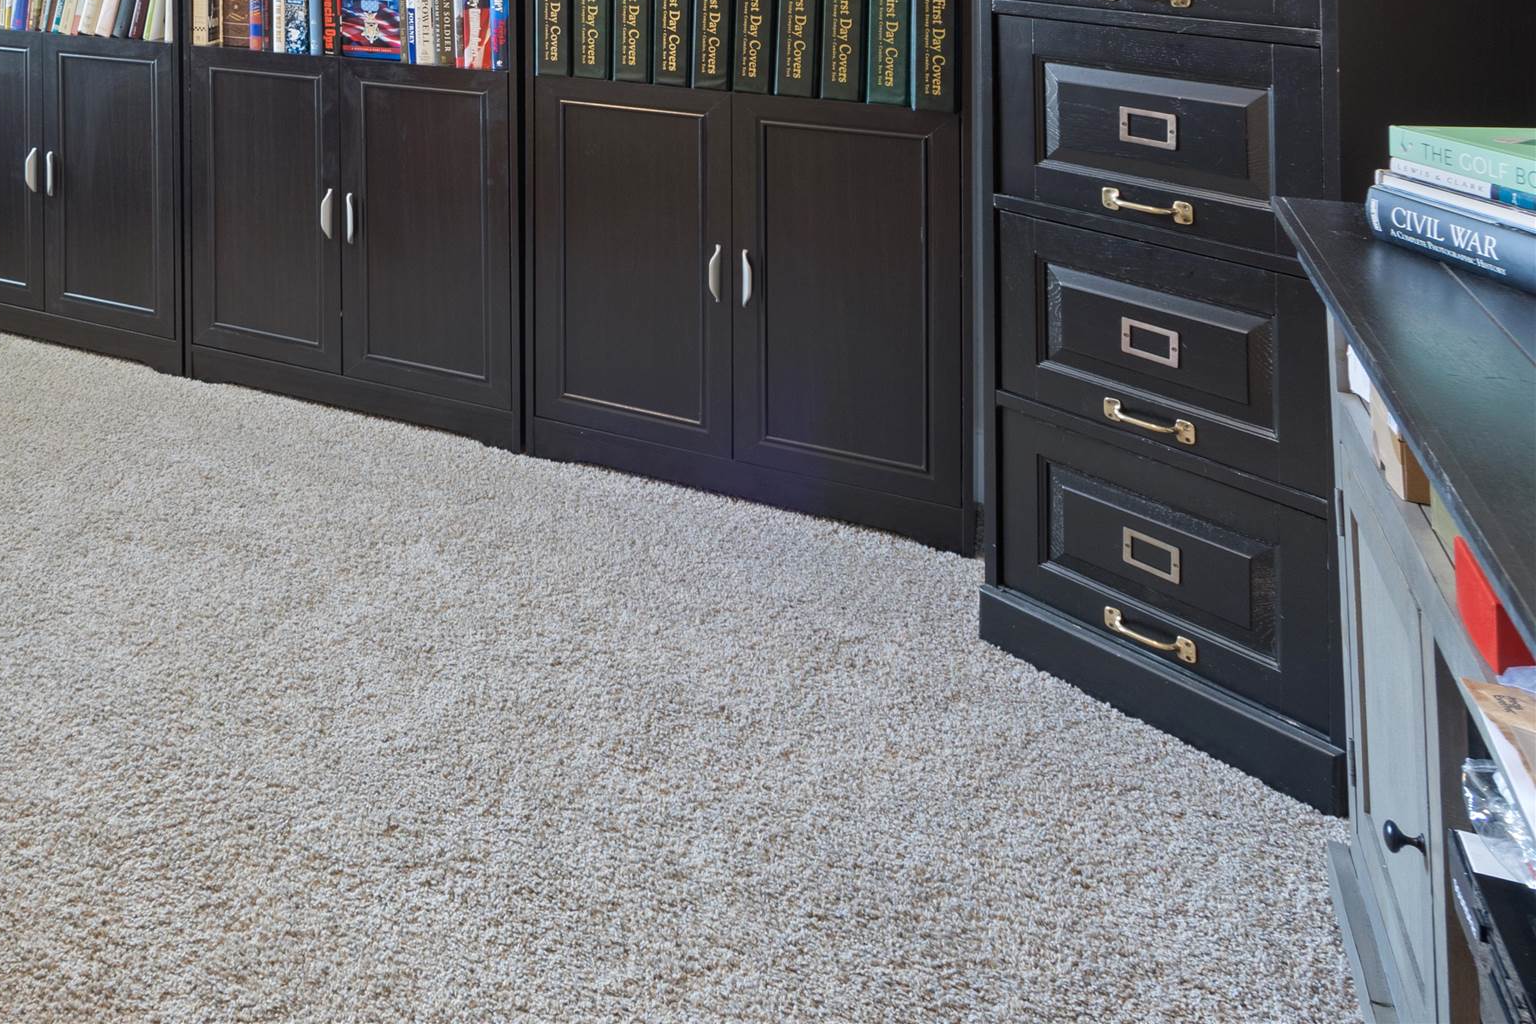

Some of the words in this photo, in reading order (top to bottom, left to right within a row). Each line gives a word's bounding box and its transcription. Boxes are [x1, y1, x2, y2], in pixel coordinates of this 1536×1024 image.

[421, 0, 430, 46] POWELL
[549, 3, 560, 24] Day
[586, 6, 598, 26] Day
[627, 5, 640, 26] Day
[667, 10, 680, 32] Day
[707, 13, 720, 34] Day
[793, 15, 806, 38] Day
[933, 0, 946, 24] First
[324, 29, 336, 49] Ops
[443, 12, 451, 52] SOLDIER
[748, 16, 762, 38] Day
[837, 19, 852, 42] Day
[884, 22, 900, 44] Day
[930, 29, 946, 52] Day
[551, 26, 560, 62] Covers
[588, 29, 598, 64] Covers
[628, 29, 640, 66] Covers
[668, 34, 680, 72] Covers
[708, 37, 720, 74] Covers
[748, 40, 762, 78] Covers
[793, 40, 806, 78] Covers
[839, 44, 852, 82] Covers
[885, 47, 898, 86] Covers
[932, 55, 946, 96] Covers
[1421, 142, 1452, 168] THE
[1458, 153, 1510, 180] GOLF
[1446, 176, 1484, 192] CLARK
[1391, 207, 1444, 242] CIVIL
[1450, 223, 1498, 260] WAR
[1476, 257, 1506, 276] HISTORY
